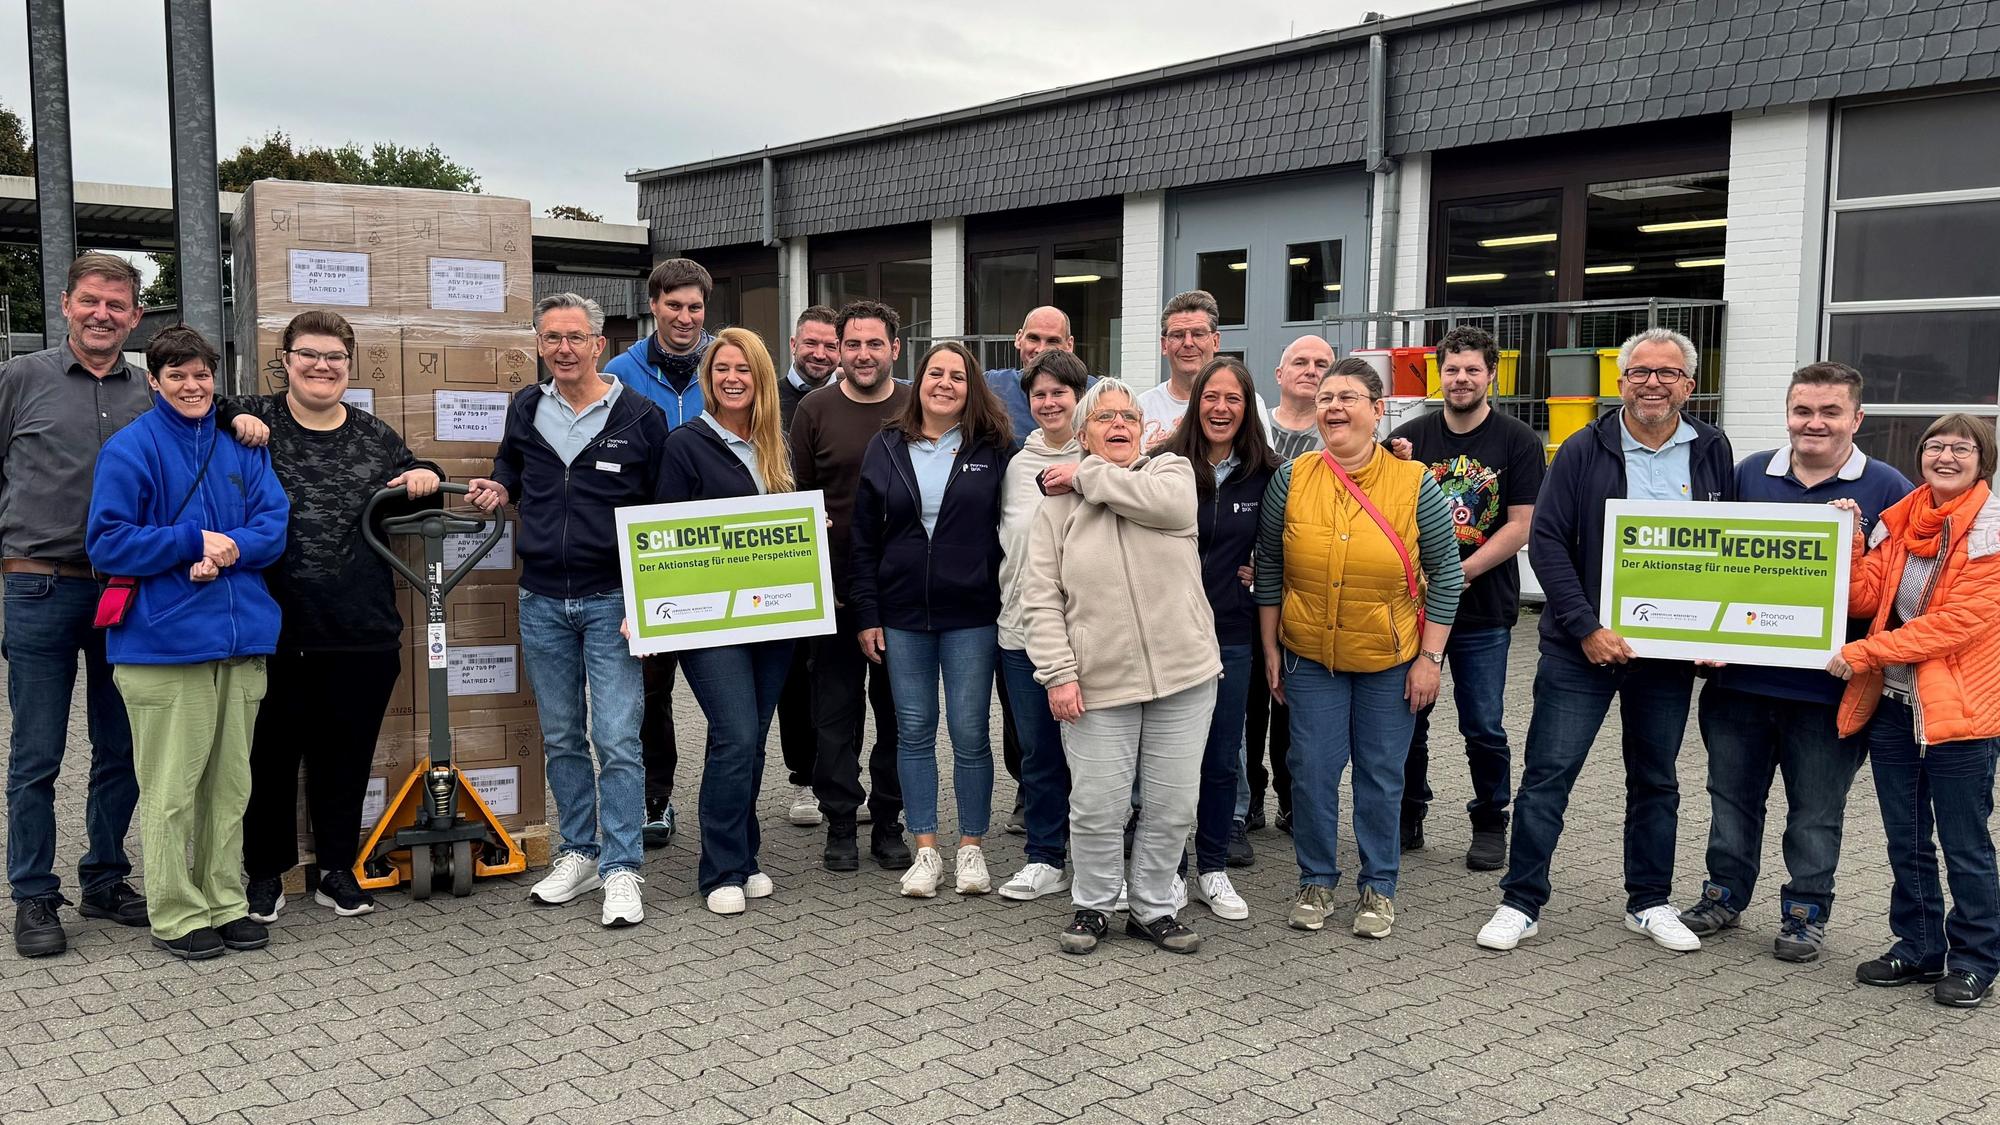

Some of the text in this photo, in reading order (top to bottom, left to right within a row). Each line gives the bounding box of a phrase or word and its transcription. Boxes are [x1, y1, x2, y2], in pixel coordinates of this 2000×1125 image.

[639, 564, 655, 572] Der
[658, 558, 709, 571] Aktionstag
[712, 556, 725, 565] für
[752, 548, 812, 562] Perspektiven
[1622, 559, 1828, 577] Der Aktionstag für neue Perspektiven
[1760, 612, 1794, 621] Pronova
